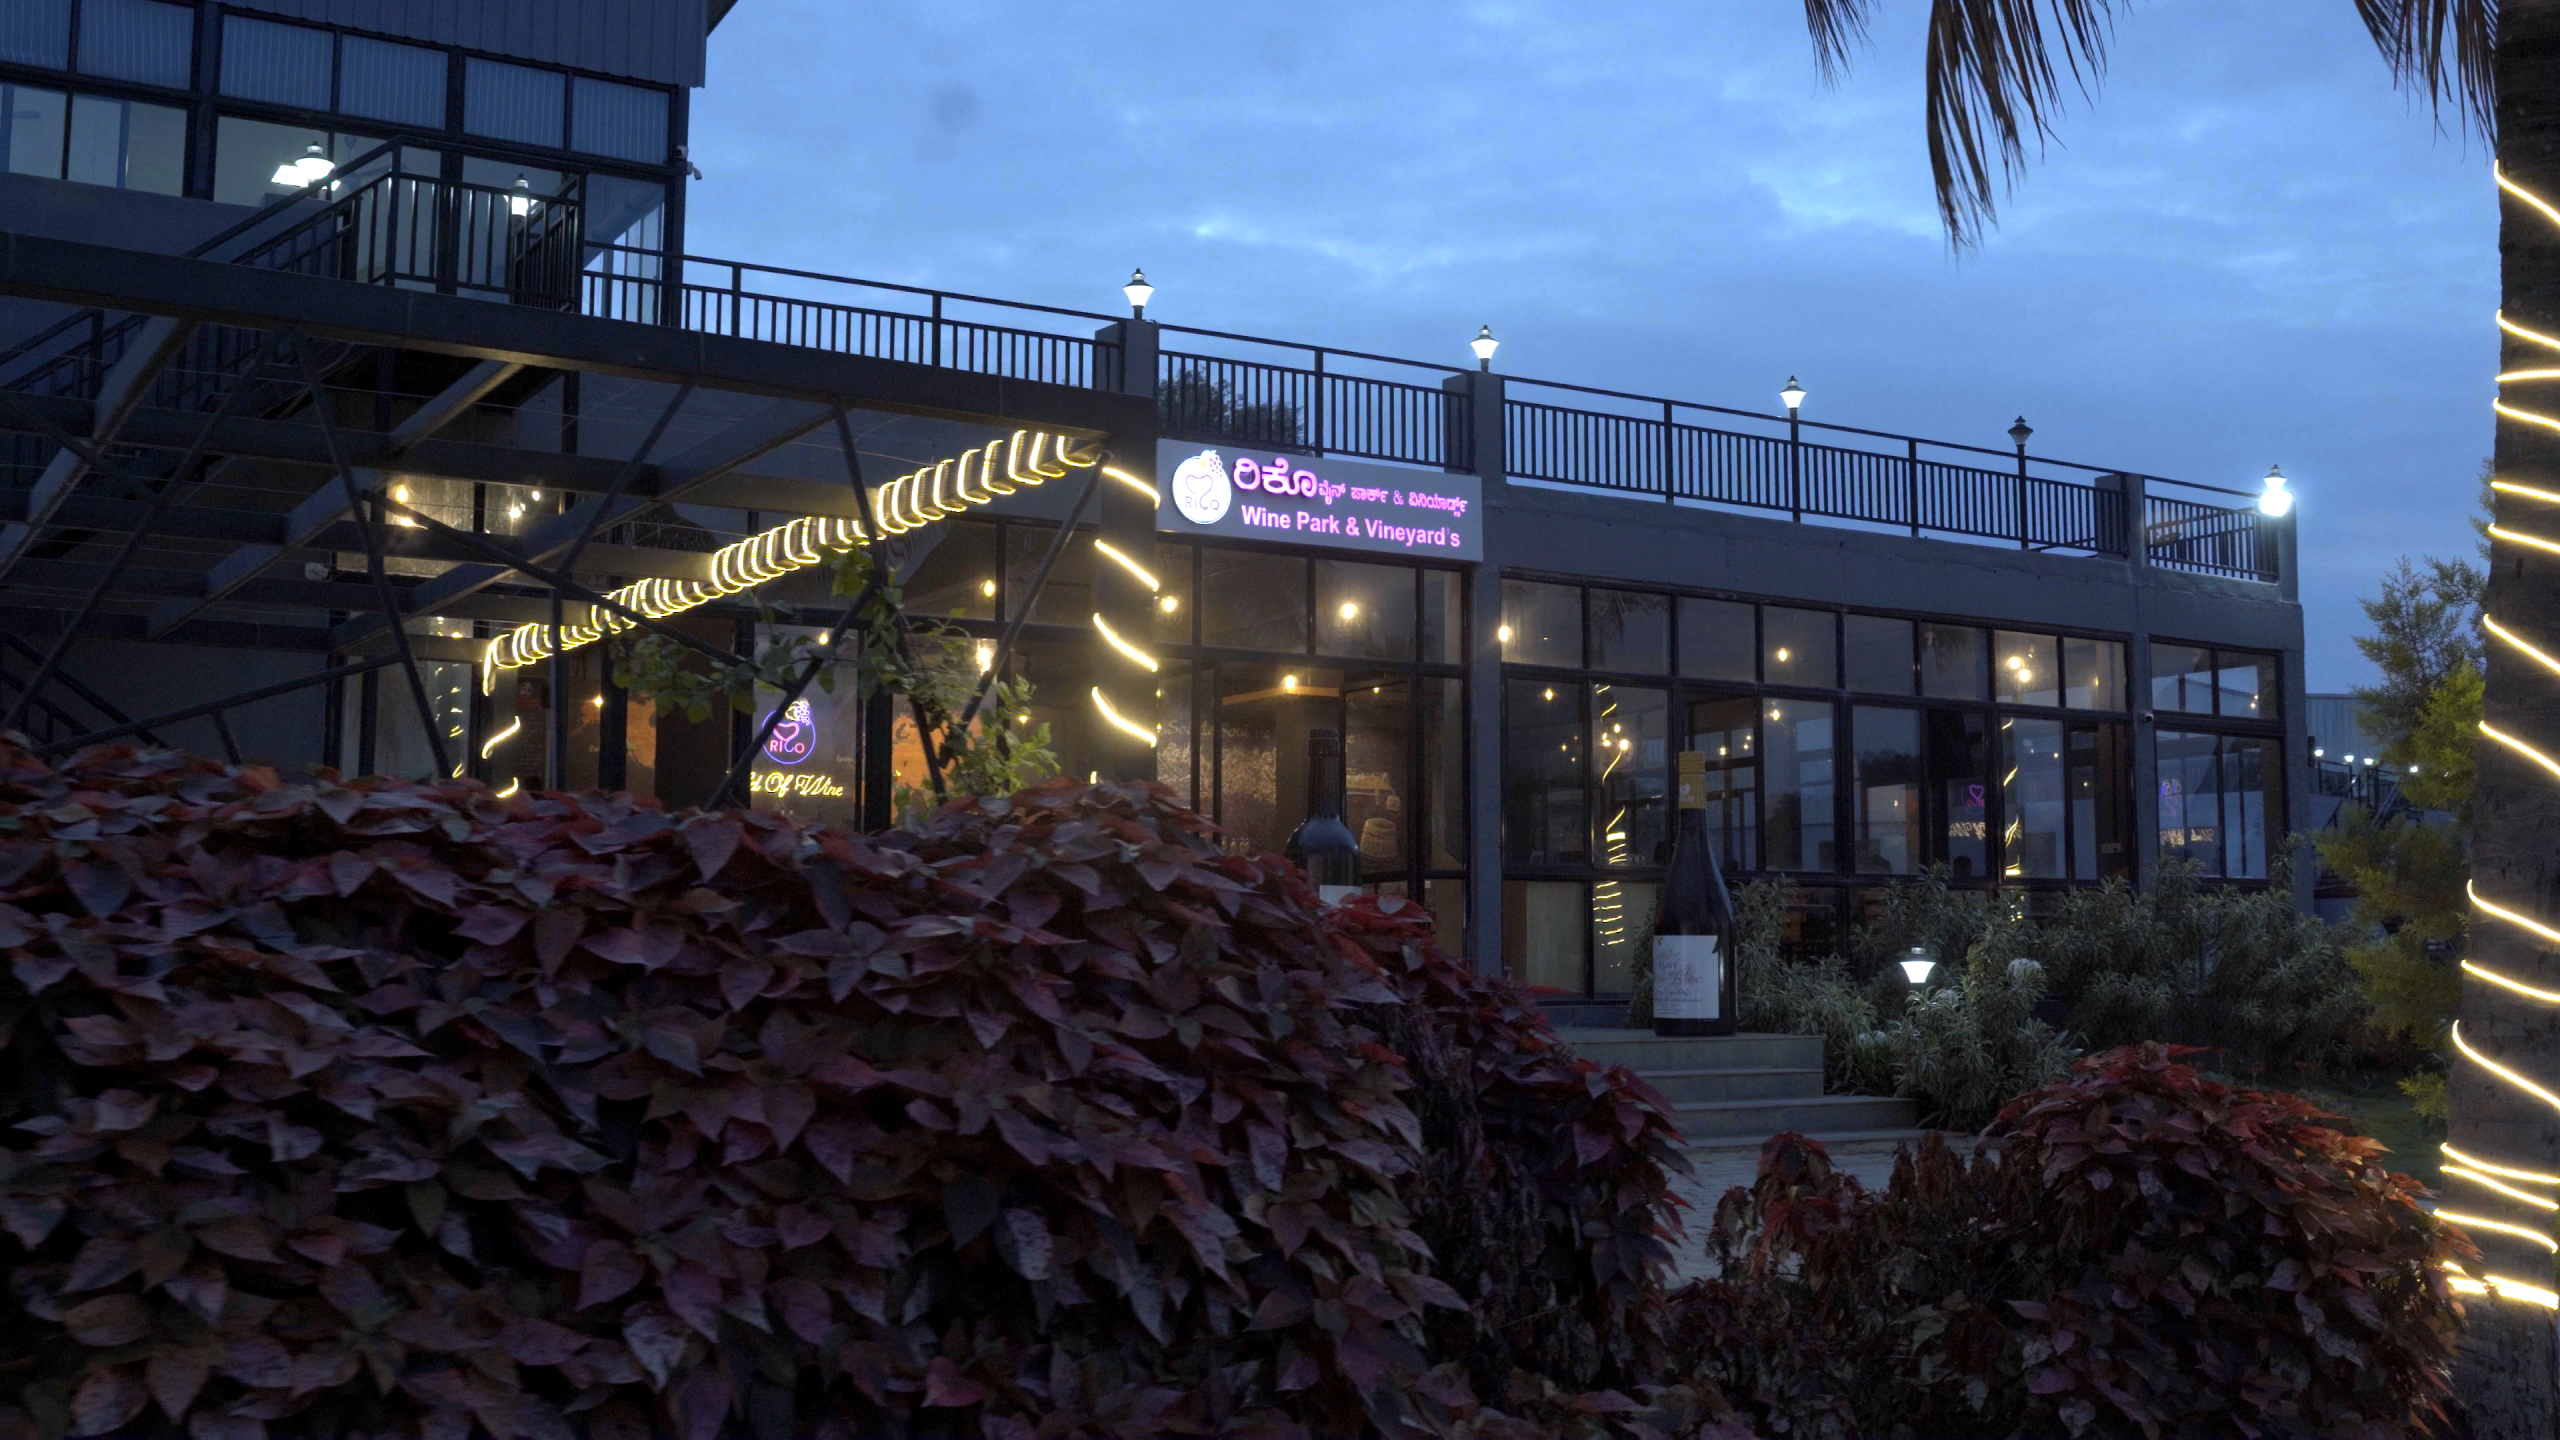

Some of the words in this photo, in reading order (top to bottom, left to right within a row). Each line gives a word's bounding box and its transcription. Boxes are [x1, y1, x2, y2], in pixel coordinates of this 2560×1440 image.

[1185, 495, 1220, 510] RICO
[1318, 479, 1346, 505] ವೈನ್
[1393, 490, 1404, 505] &
[1241, 505, 1291, 529] Wine
[1297, 511, 1341, 534] Park
[1345, 516, 1360, 537] &
[769, 738, 805, 754] RICO
[765, 772, 793, 798] Of
[794, 774, 844, 797] Wine
